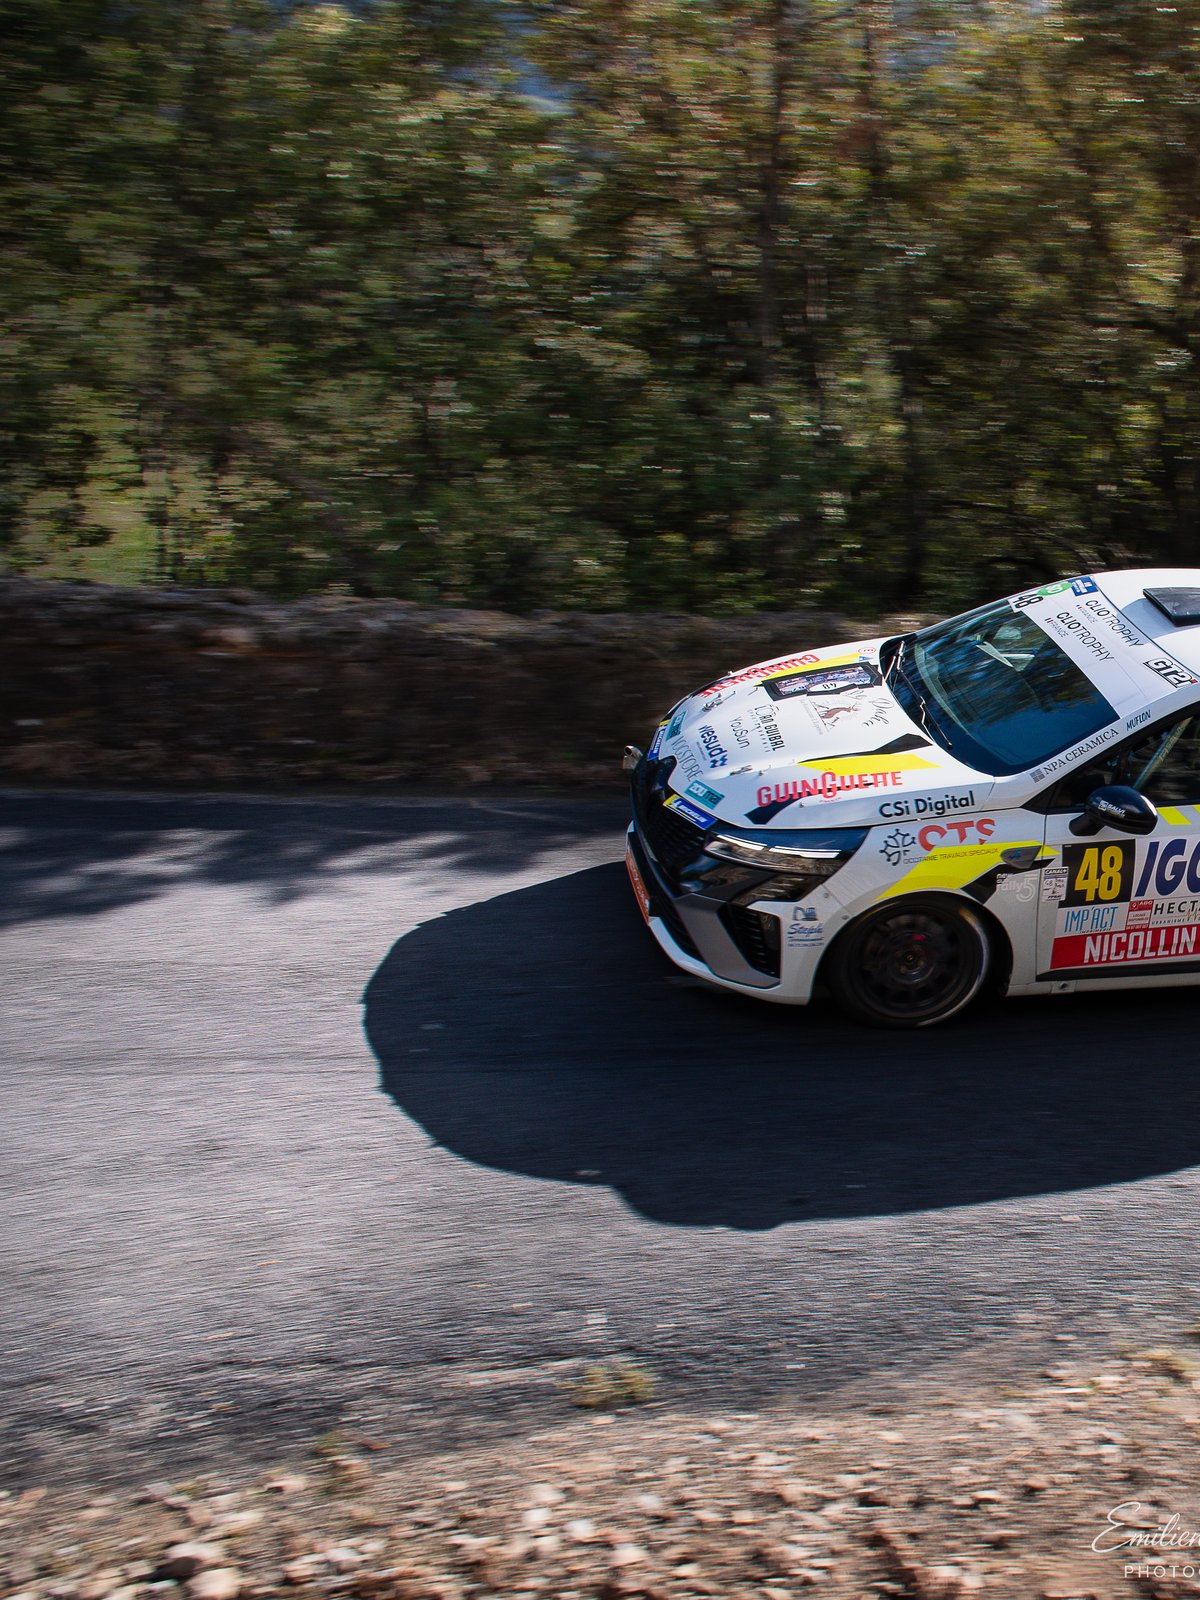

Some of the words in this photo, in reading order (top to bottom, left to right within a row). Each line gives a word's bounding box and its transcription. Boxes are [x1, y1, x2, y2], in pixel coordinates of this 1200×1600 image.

[699, 725, 728, 758] wesud
[1044, 758, 1067, 775] NPA
[1065, 728, 1120, 762] CERAMICA
[757, 771, 902, 808] GUINGUETTE
[915, 790, 976, 815] Digital
[1074, 845, 1124, 902] 48
[1083, 927, 1198, 964] NICOLLIN
